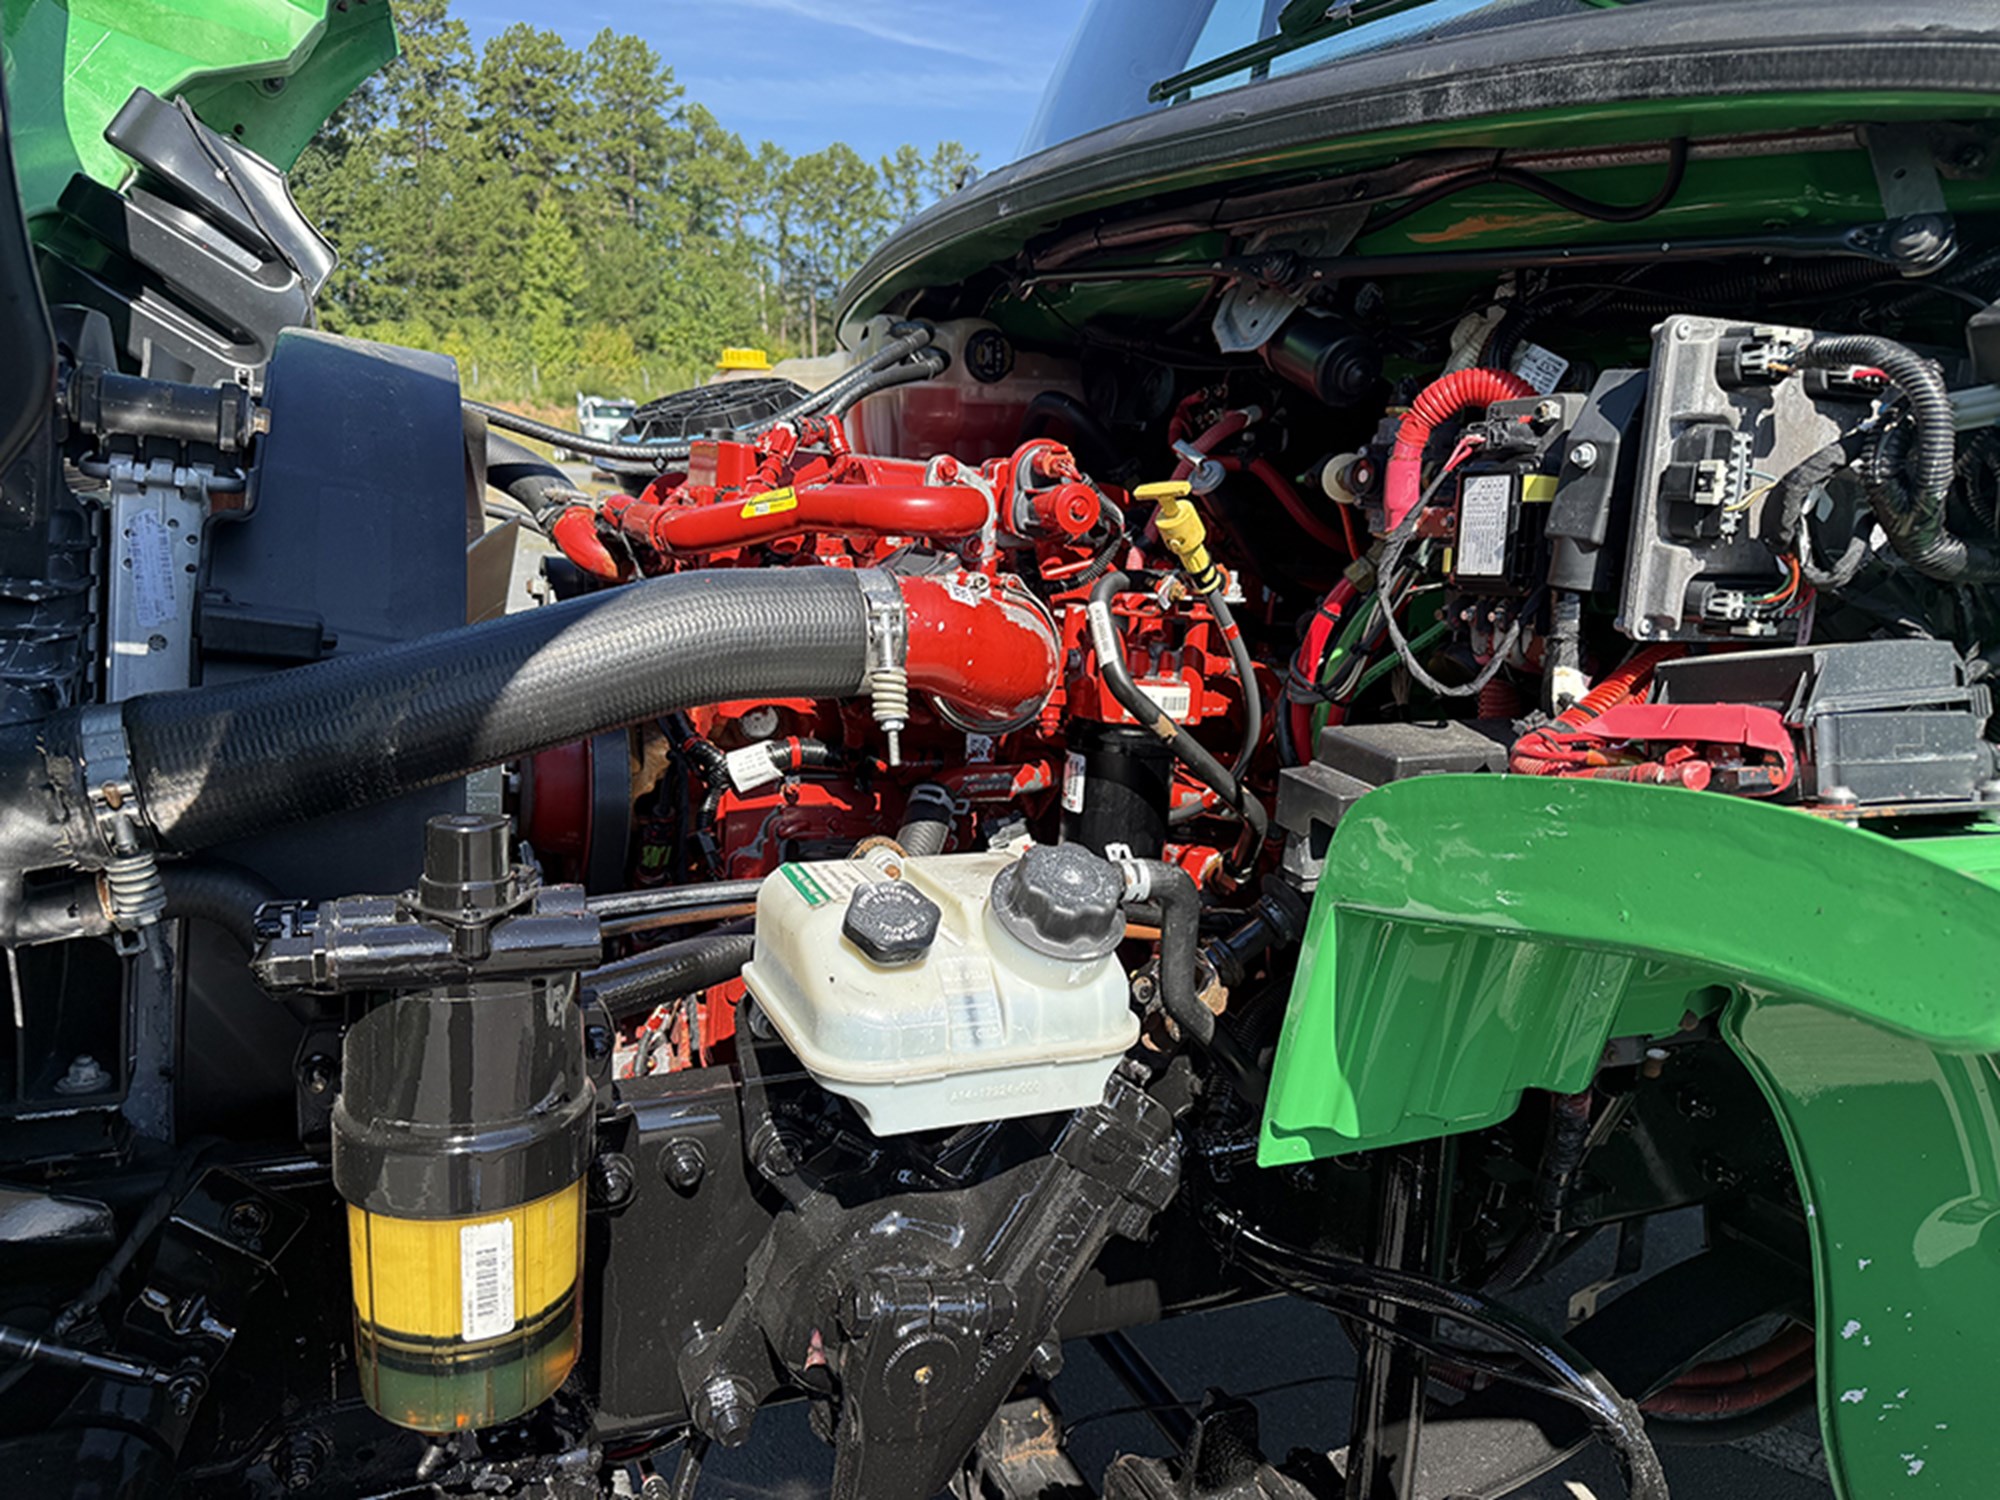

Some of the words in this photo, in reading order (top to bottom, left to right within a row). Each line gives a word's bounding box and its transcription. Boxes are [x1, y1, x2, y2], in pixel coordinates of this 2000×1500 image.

[858, 884, 879, 908] POWER
[880, 886, 920, 905] STEERING
[873, 894, 903, 904] FLUID
